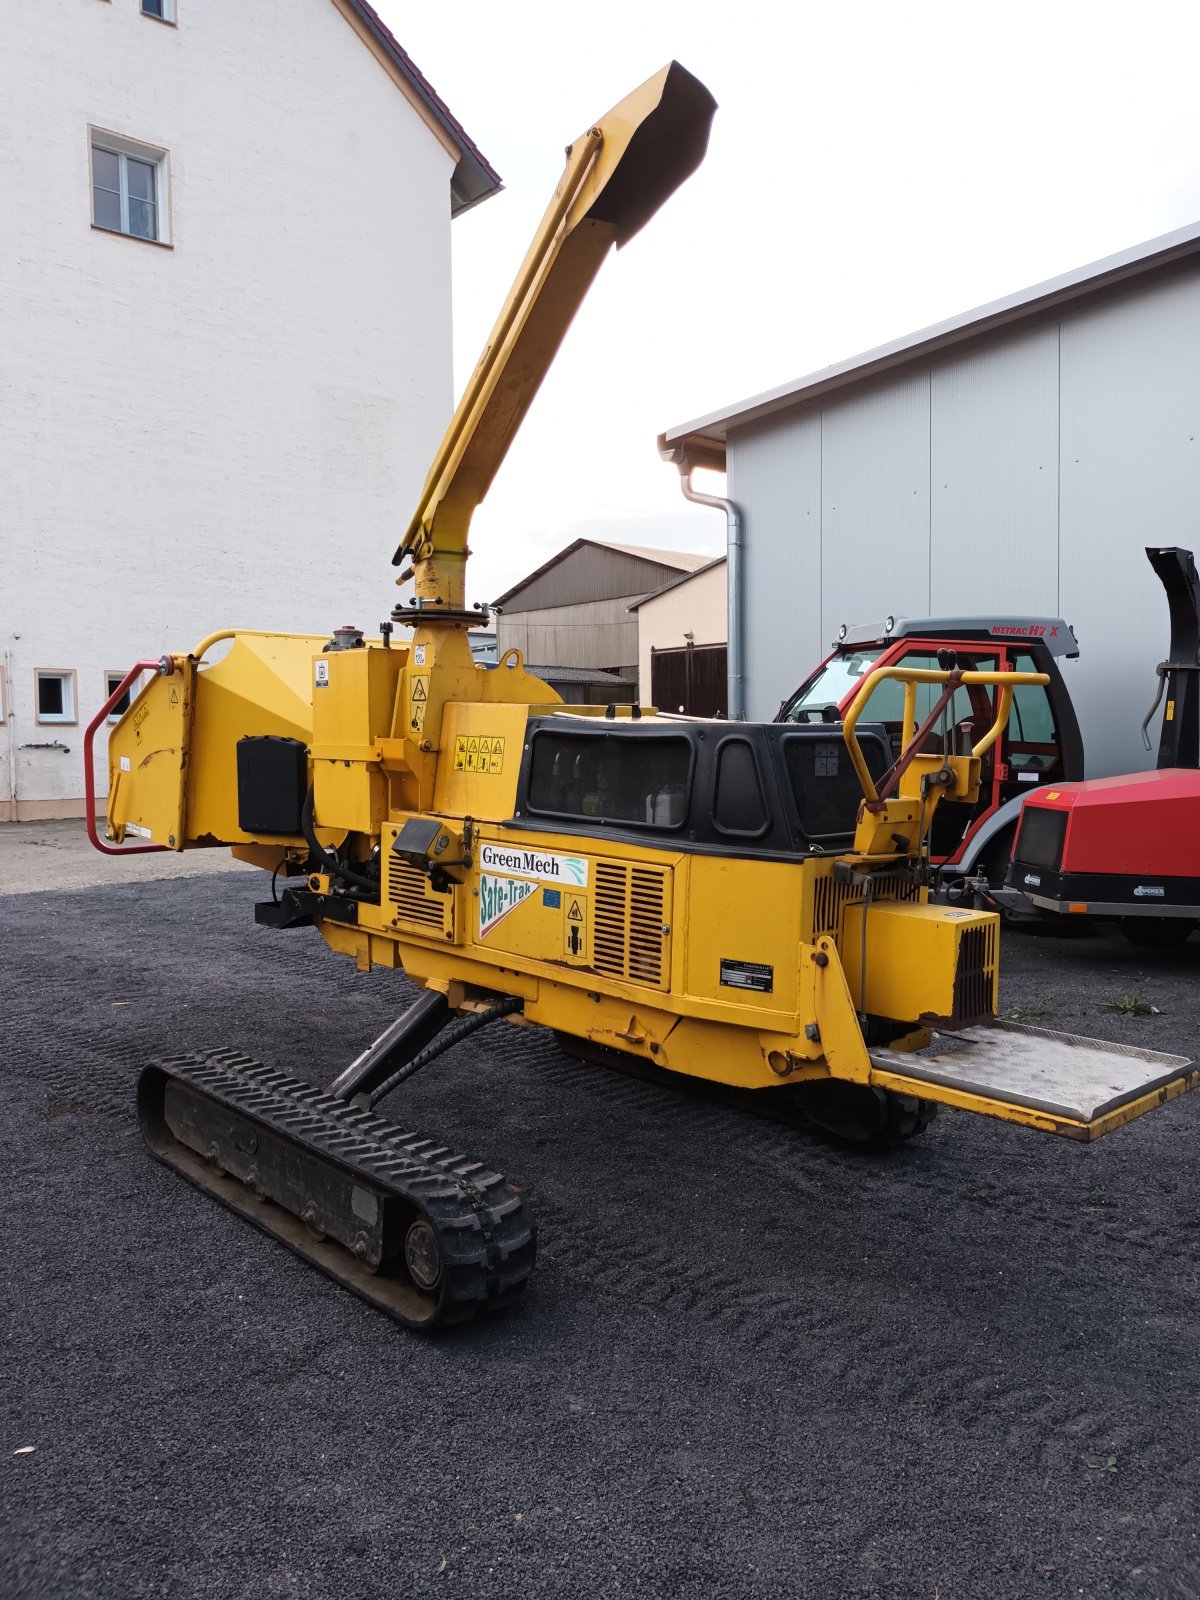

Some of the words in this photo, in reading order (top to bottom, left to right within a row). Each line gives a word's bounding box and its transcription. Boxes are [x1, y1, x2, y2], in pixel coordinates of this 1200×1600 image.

[991, 626, 1028, 635] METRAC
[1028, 625, 1047, 636] H7
[1049, 626, 1059, 637] X
[482, 846, 560, 876] GreenMech
[480, 875, 531, 926] Safe-Trak
